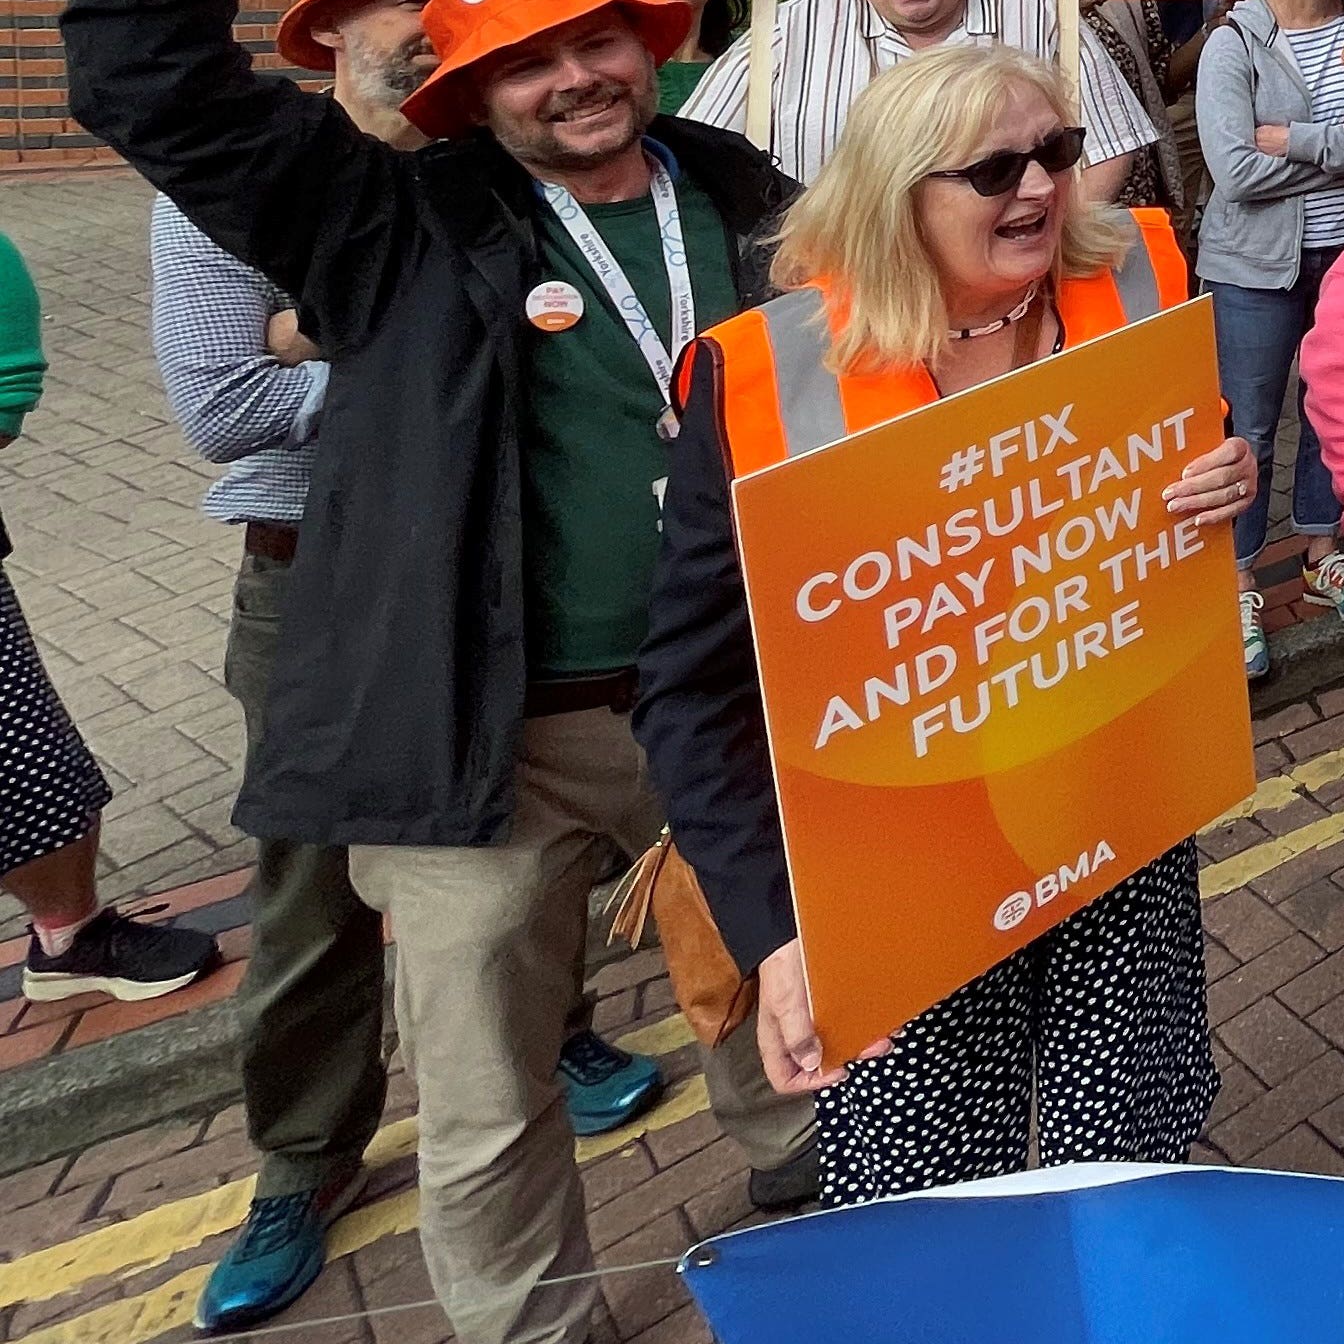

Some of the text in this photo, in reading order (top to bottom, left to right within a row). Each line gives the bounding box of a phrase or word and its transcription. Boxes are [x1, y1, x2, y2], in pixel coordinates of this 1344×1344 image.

[579, 232, 610, 277] Yorkshire
[679, 292, 690, 342] Yorkshire
[941, 403, 1079, 494] #FIX
[796, 408, 1197, 624] CONSULTANT
[883, 489, 1144, 650] PAY NOW
[814, 515, 1206, 751] AND FOR THE
[912, 602, 1145, 758] FUTURE
[1034, 840, 1117, 909] BMA
